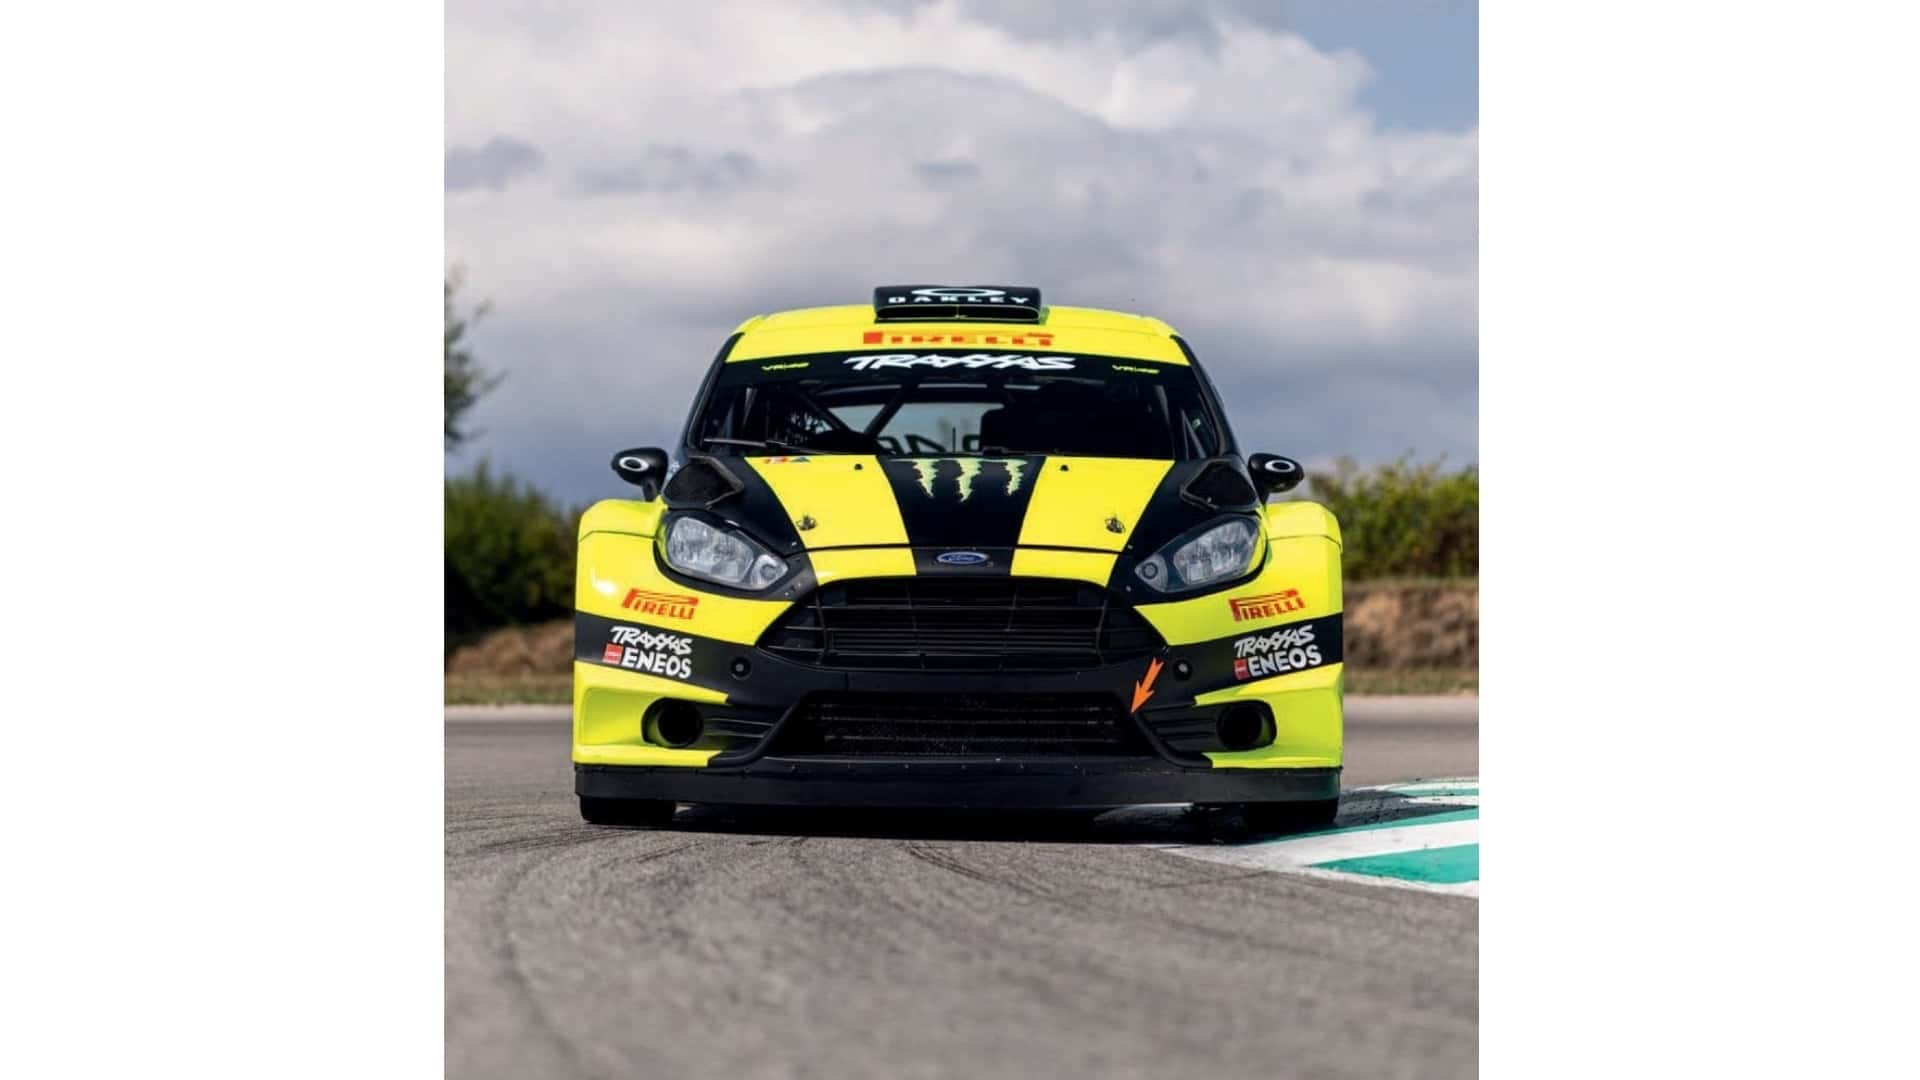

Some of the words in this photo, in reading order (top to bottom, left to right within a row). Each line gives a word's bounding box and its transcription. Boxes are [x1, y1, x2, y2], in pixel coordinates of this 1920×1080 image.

[888, 296, 1029, 304] OAKLEY
[843, 354, 1076, 370] TRAXXAS
[621, 588, 699, 620] PIRELLI
[1229, 588, 1306, 622] PIRELLI
[610, 626, 693, 656] TRAXXAS
[1234, 624, 1315, 658] TRAXXAS
[621, 646, 692, 679] ENEOS
[1247, 644, 1322, 677] ENEOS
